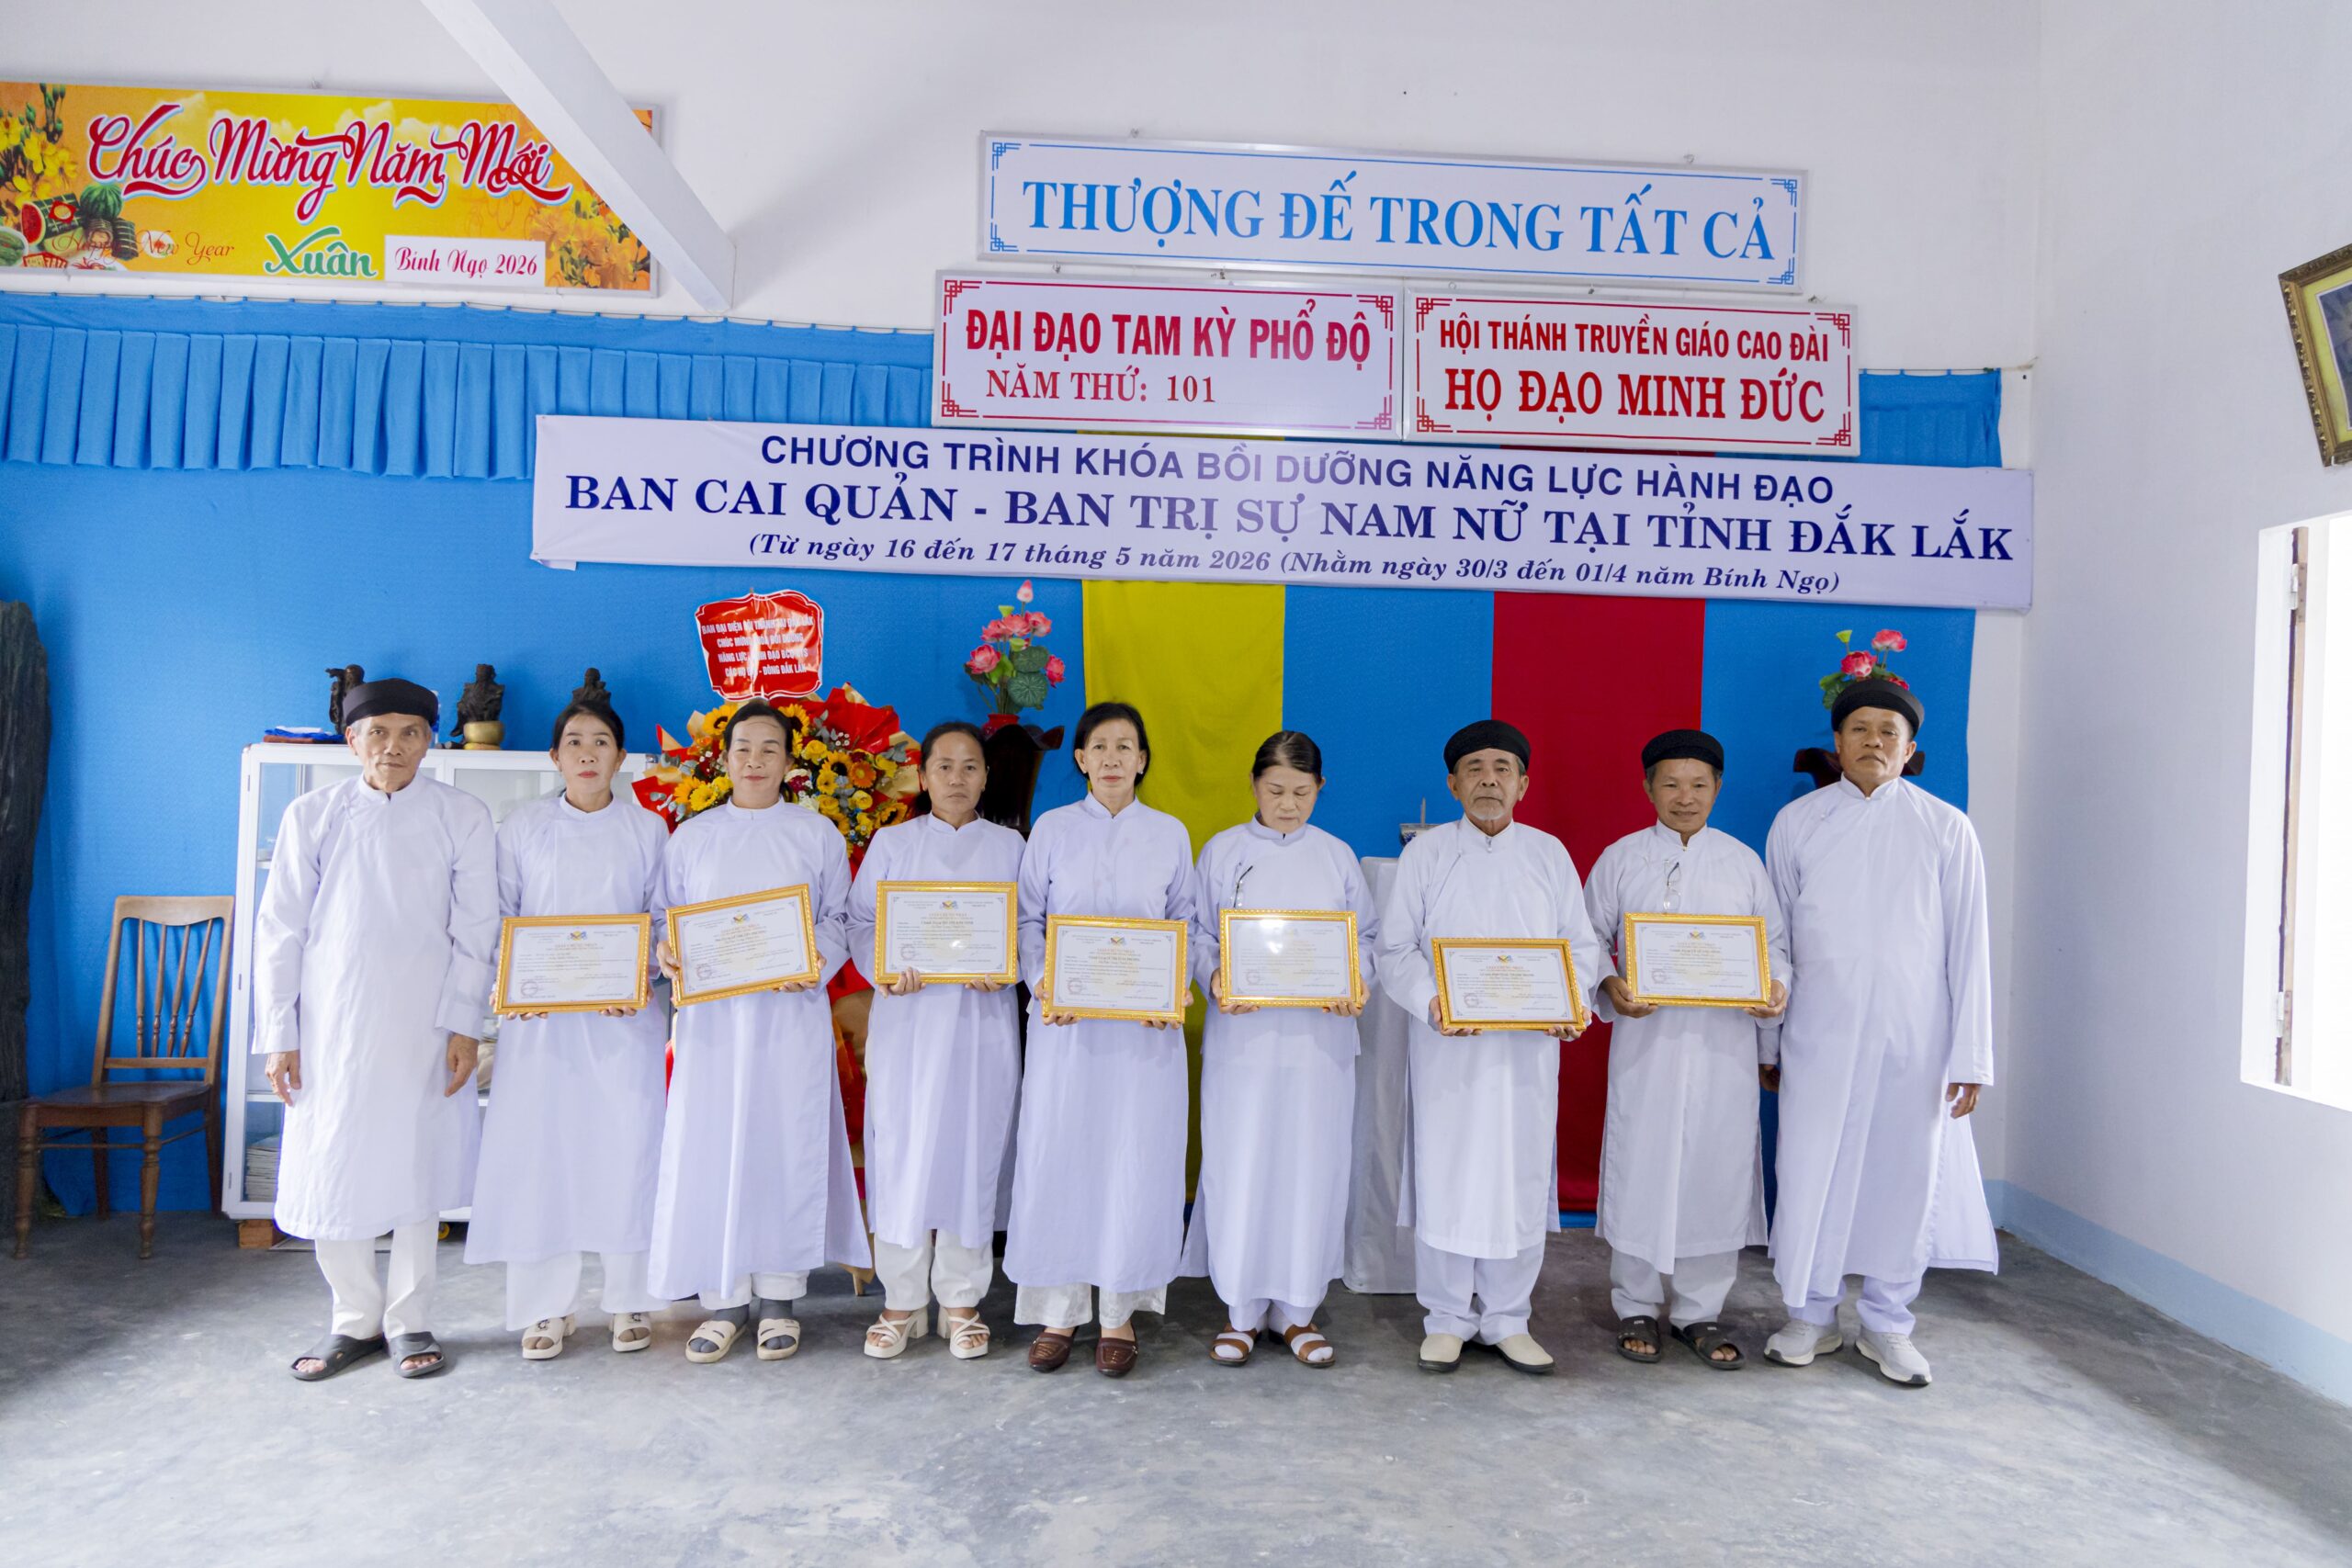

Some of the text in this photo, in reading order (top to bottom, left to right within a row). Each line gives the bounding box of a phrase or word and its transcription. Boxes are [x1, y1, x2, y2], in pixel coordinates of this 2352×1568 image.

[89, 104, 572, 223] Chúc Mừng Năm Mới
[1023, 170, 1774, 260] THƯỢNG ĐẾ TRONG TẤT CẢ
[136, 230, 179, 256] New
[186, 231, 234, 265] Year
[264, 226, 377, 277] Xuân
[447, 249, 489, 279] Ngọ
[495, 254, 537, 276] 2026
[966, 298, 1371, 371] ĐẠI ĐẠO TAM KỲ PHỔ ĐỘ
[1440, 311, 1828, 362] HỘI THÁNH TRUYỀN GIÁO CAO ĐÀI
[986, 363, 1215, 402] NĂM THỨ: 101
[1444, 367, 1825, 423] HỌ ĐẠO MINH ĐỨC
[762, 434, 1833, 508] CHƯƠNG TRÌNH KHÓA BỒI DƯỠNG NĂNG LỰC HÀNH ĐẠO
[565, 475, 679, 512] BAN
[695, 479, 787, 516] CAI
[805, 471, 958, 526] QUẢN
[1004, 491, 1114, 527] BAN
[1129, 495, 1219, 540] TRỊ
[1237, 492, 1306, 543] SỰ
[1320, 502, 1437, 539] NAM
[1452, 499, 1529, 542] NỮ
[1544, 510, 1631, 554] TẠI
[1646, 502, 1772, 551] TỈNH
[1788, 502, 1896, 557] ĐẮK
[1911, 508, 2014, 560] LẮK
[750, 534, 1839, 594] (Từ ngày 16 đến 17 tháng 5 năm 2026 (Nhằm ngày 30/3 đến 01/4 năm Bính Ngọ)
